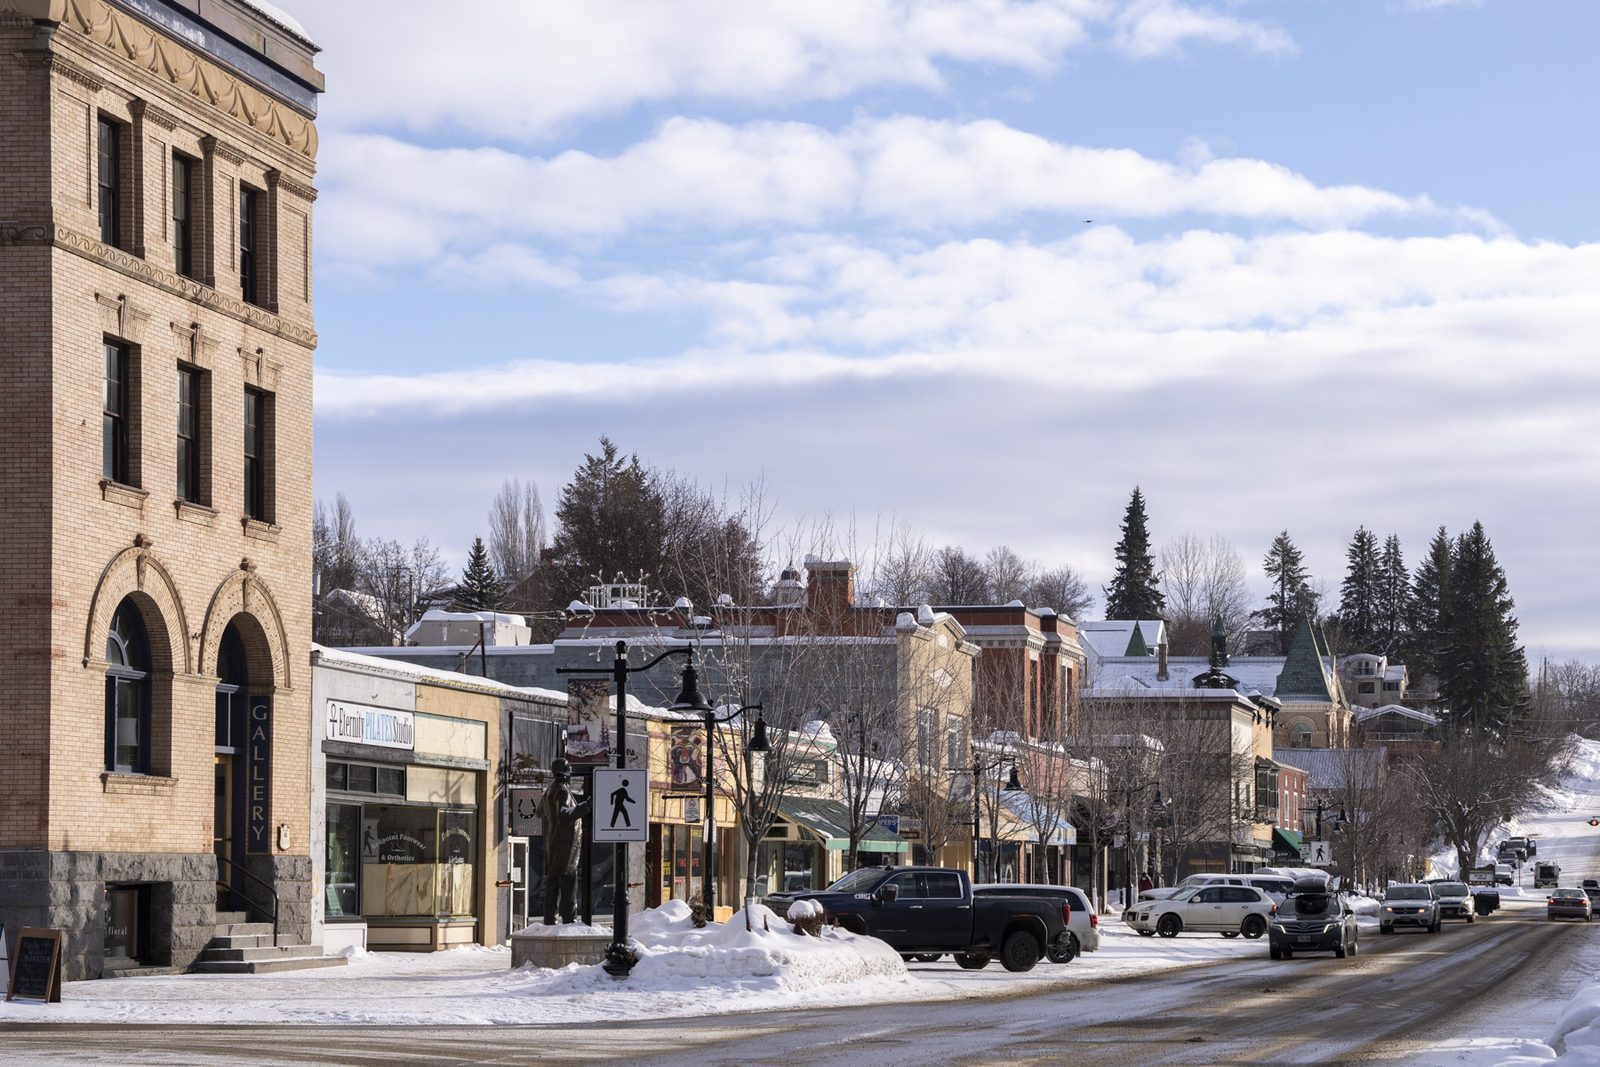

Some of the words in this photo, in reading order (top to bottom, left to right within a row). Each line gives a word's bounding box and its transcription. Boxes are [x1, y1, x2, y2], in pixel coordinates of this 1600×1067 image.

[339, 707, 364, 743] Eternity
[365, 711, 392, 742] PILATES
[393, 715, 412, 745] Studio
[252, 704, 267, 841] GALLERY
[400, 834, 426, 850] Footwear
[387, 854, 415, 862] Orthotics
